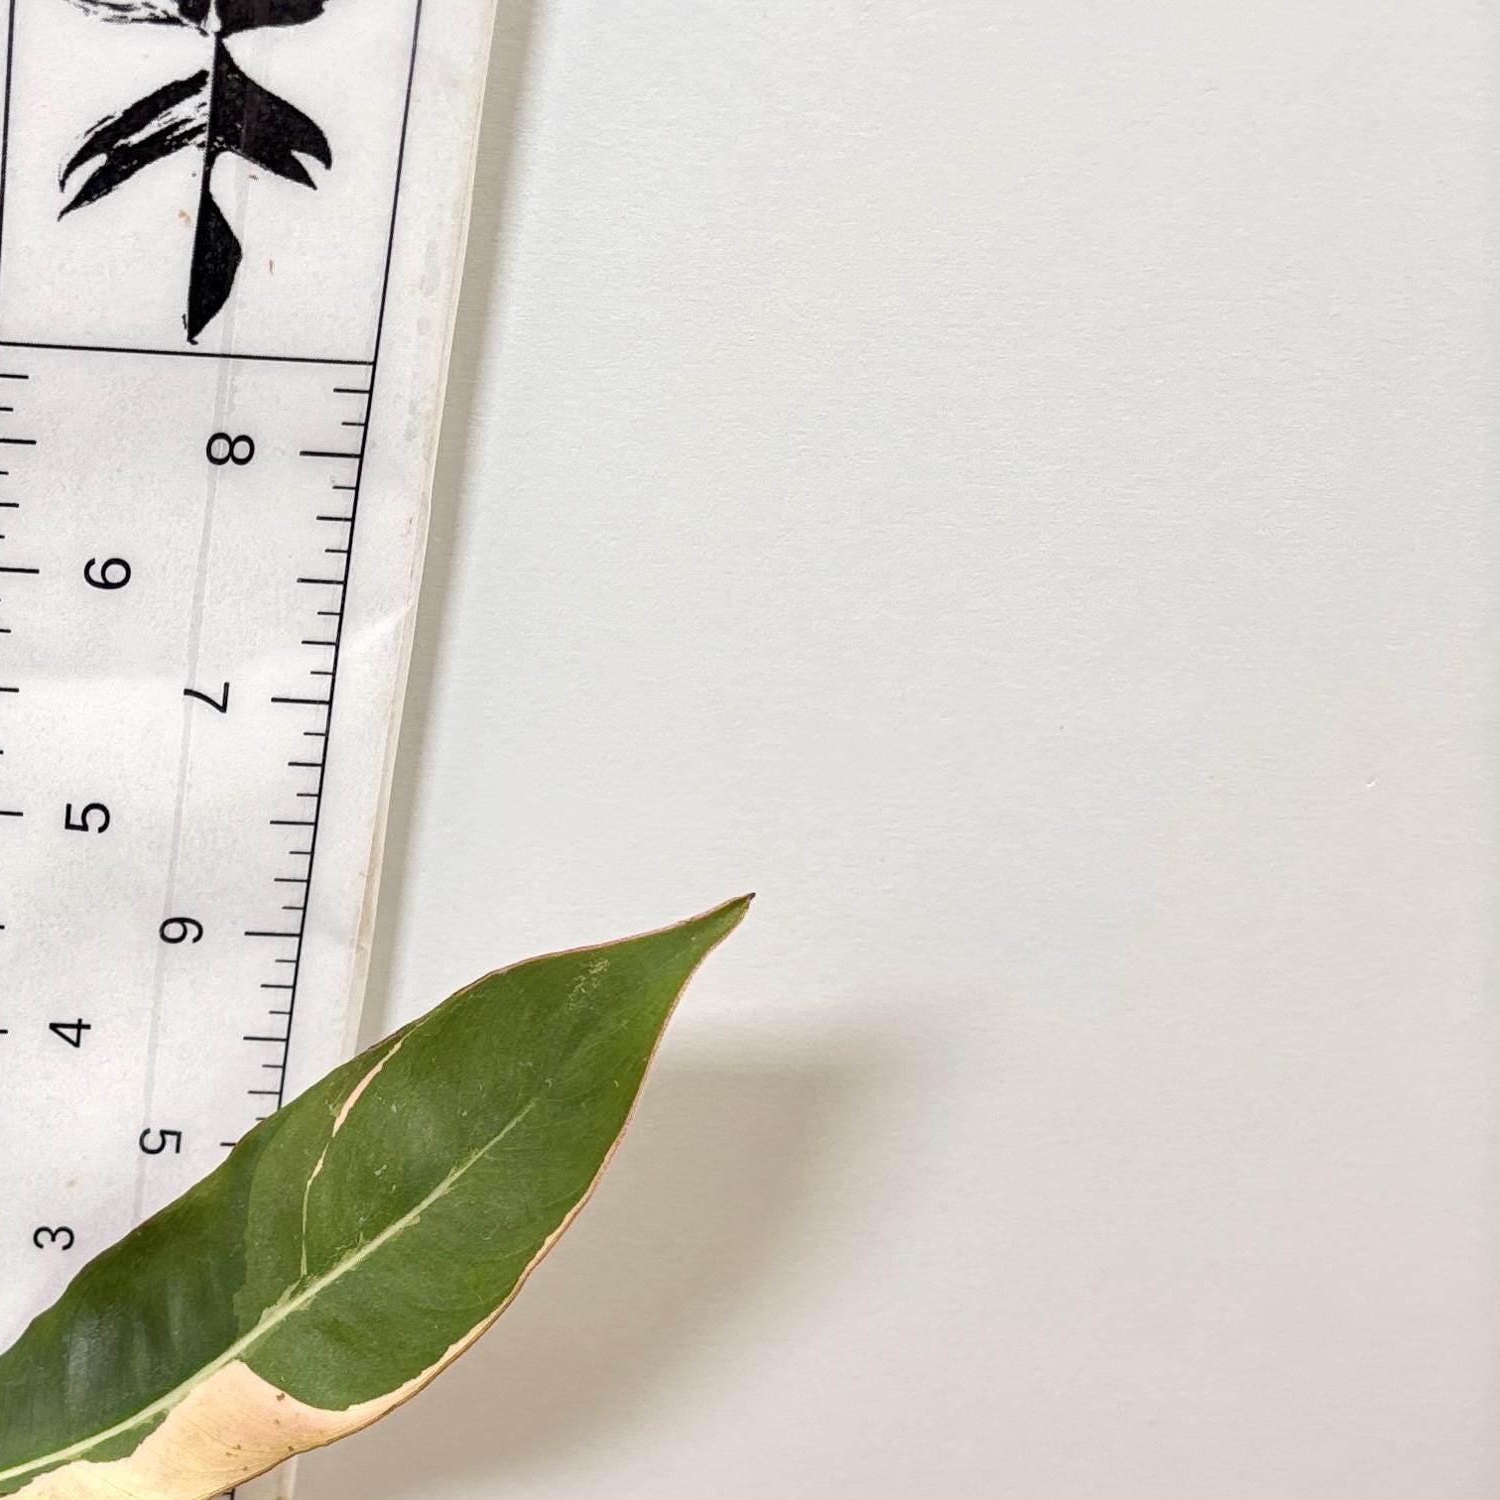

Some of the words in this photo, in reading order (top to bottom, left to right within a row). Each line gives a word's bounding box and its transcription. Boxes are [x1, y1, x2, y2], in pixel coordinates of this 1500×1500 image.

[206, 432, 255, 466] 8
[83, 557, 132, 590] 6
[183, 681, 230, 714] 7
[64, 802, 111, 834] 5
[159, 916, 204, 944] 6
[48, 1018, 92, 1048] 4
[139, 1128, 182, 1155] 5
[33, 1226, 75, 1251] 3
